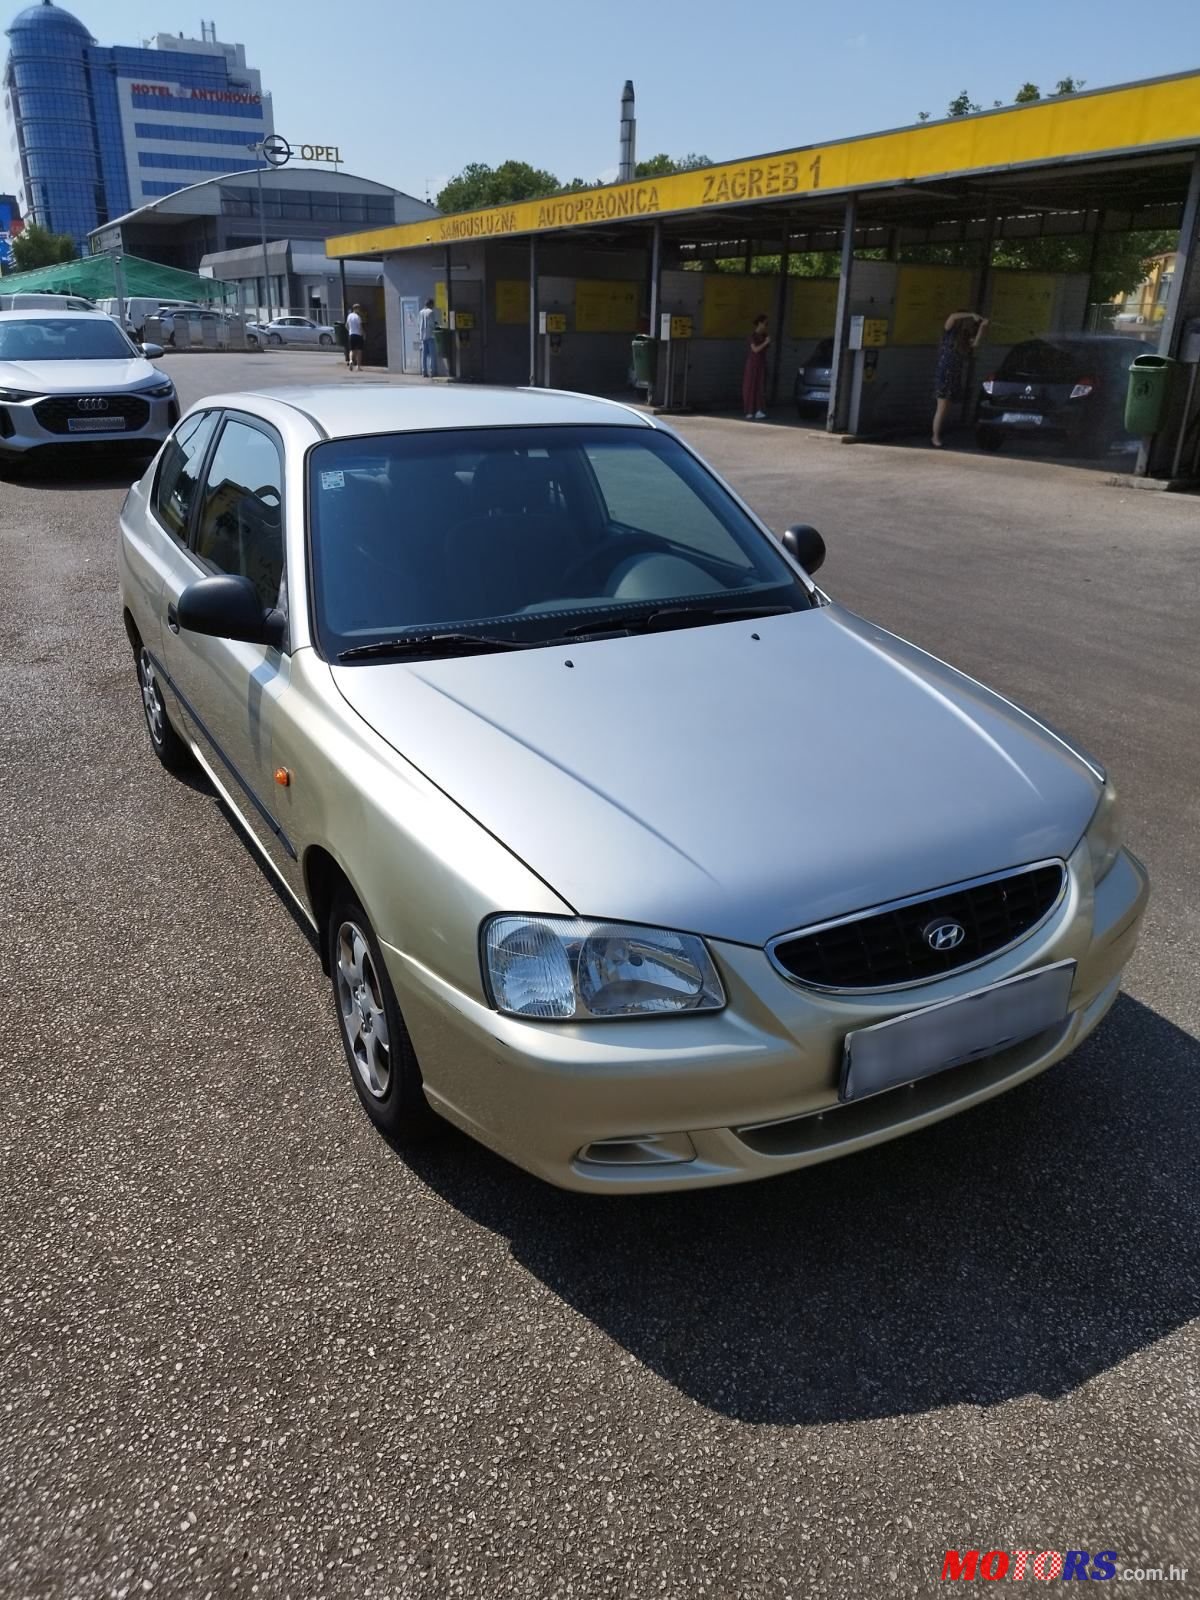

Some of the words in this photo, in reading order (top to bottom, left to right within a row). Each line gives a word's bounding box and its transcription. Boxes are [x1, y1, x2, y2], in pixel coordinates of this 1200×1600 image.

[131, 84, 173, 97] HOTEL
[301, 145, 344, 163] OPEL
[538, 186, 660, 228] AUTOPRAONICA
[701, 160, 799, 204] ZAGREB
[809, 154, 821, 189] 1
